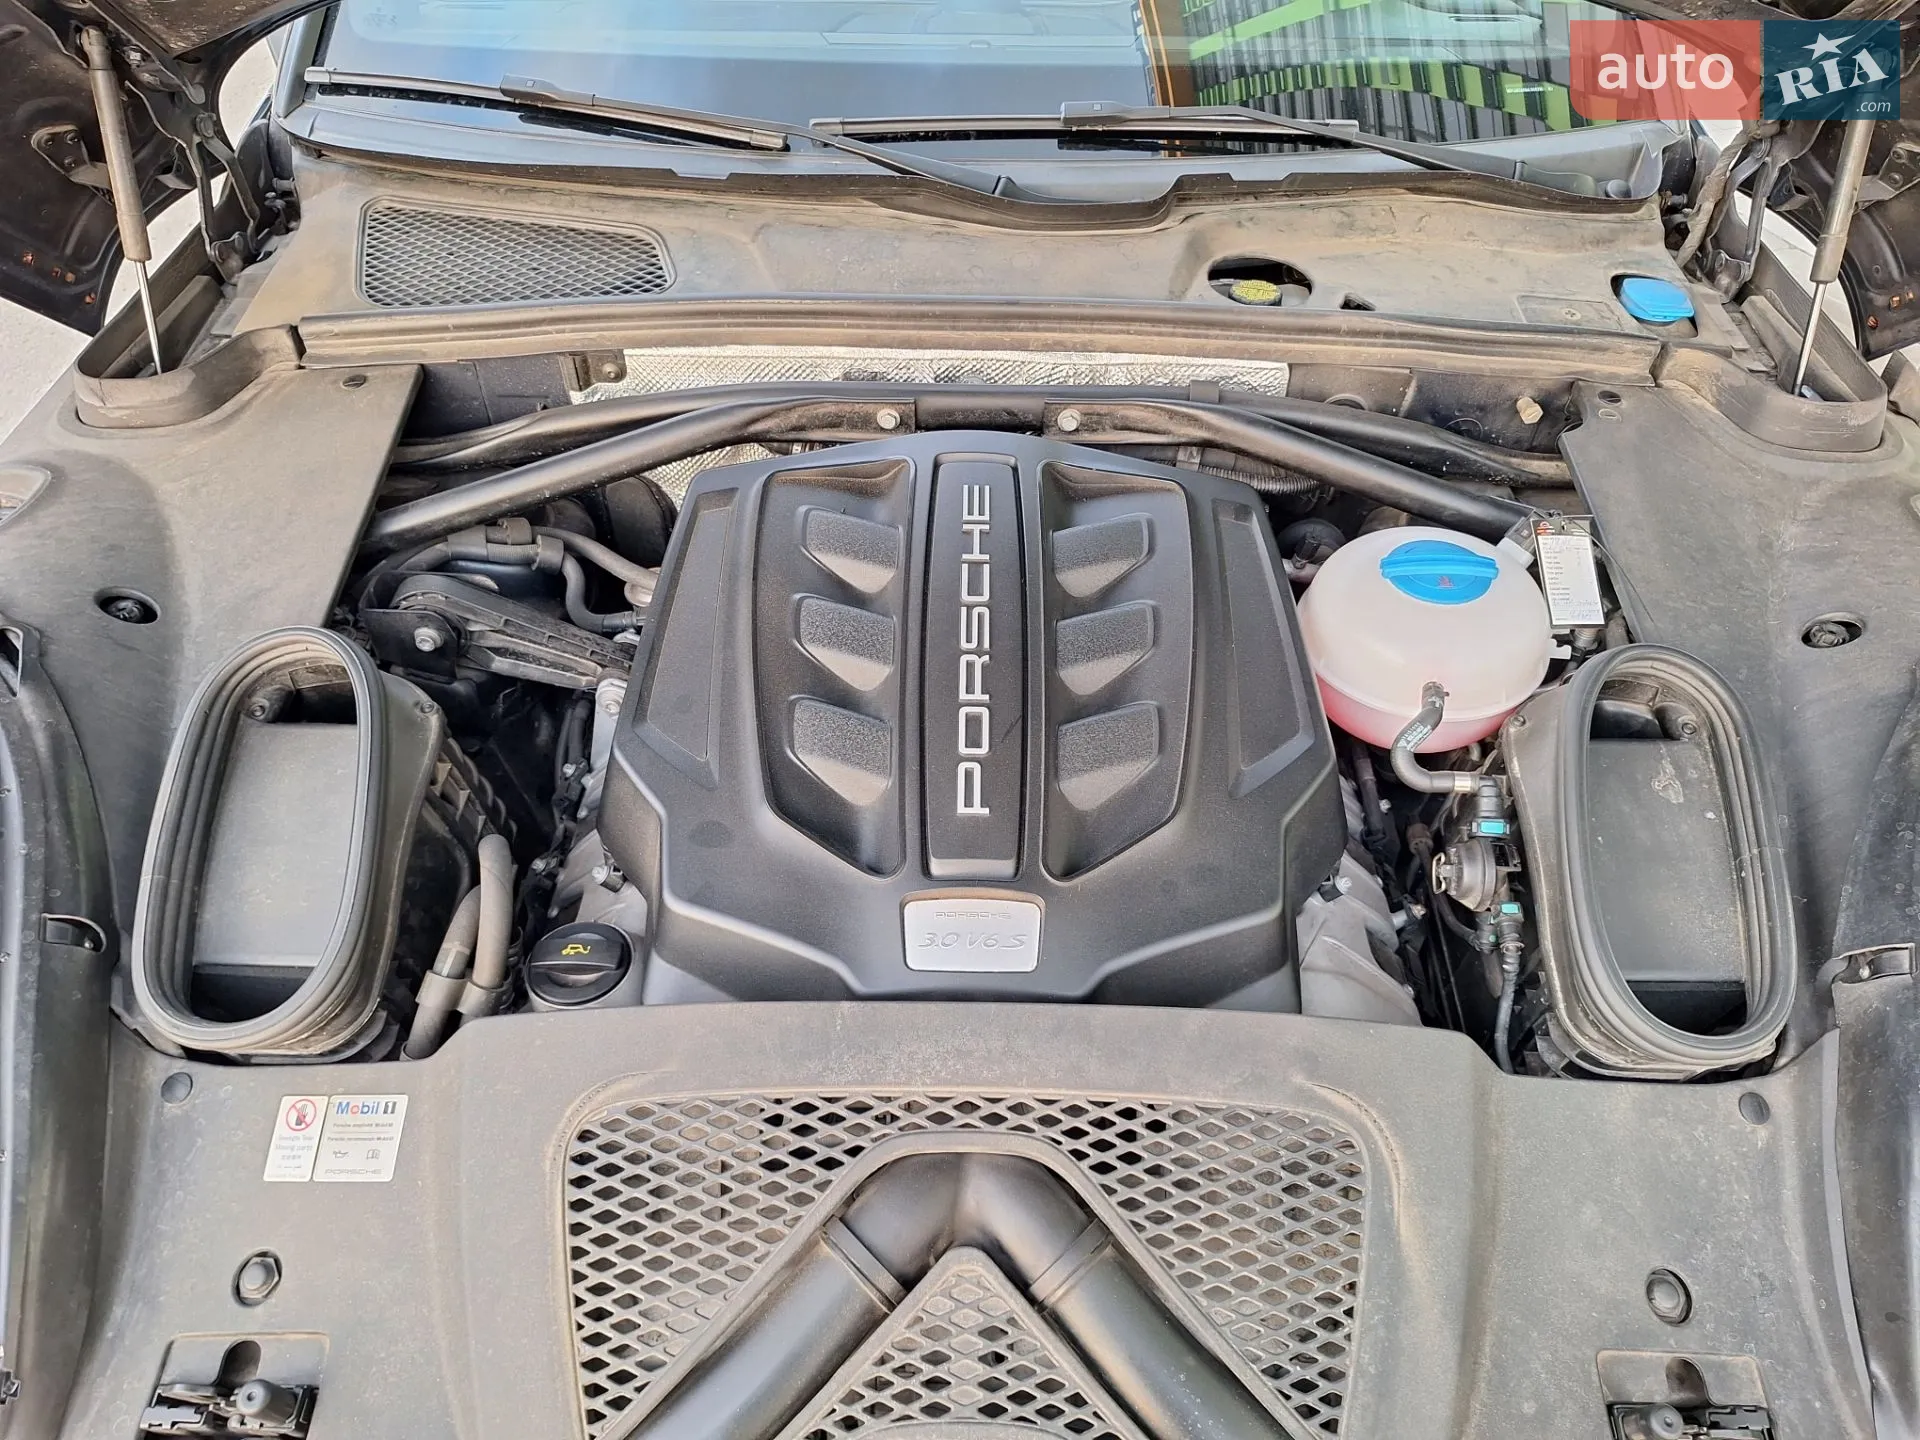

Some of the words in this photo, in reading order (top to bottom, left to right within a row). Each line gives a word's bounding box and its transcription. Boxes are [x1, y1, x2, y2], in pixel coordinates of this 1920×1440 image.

[957, 485, 990, 815] PORSCHE
[918, 932, 961, 949] 3.0
[336, 1101, 380, 1115] Mobil
[383, 1101, 397, 1114] 1
